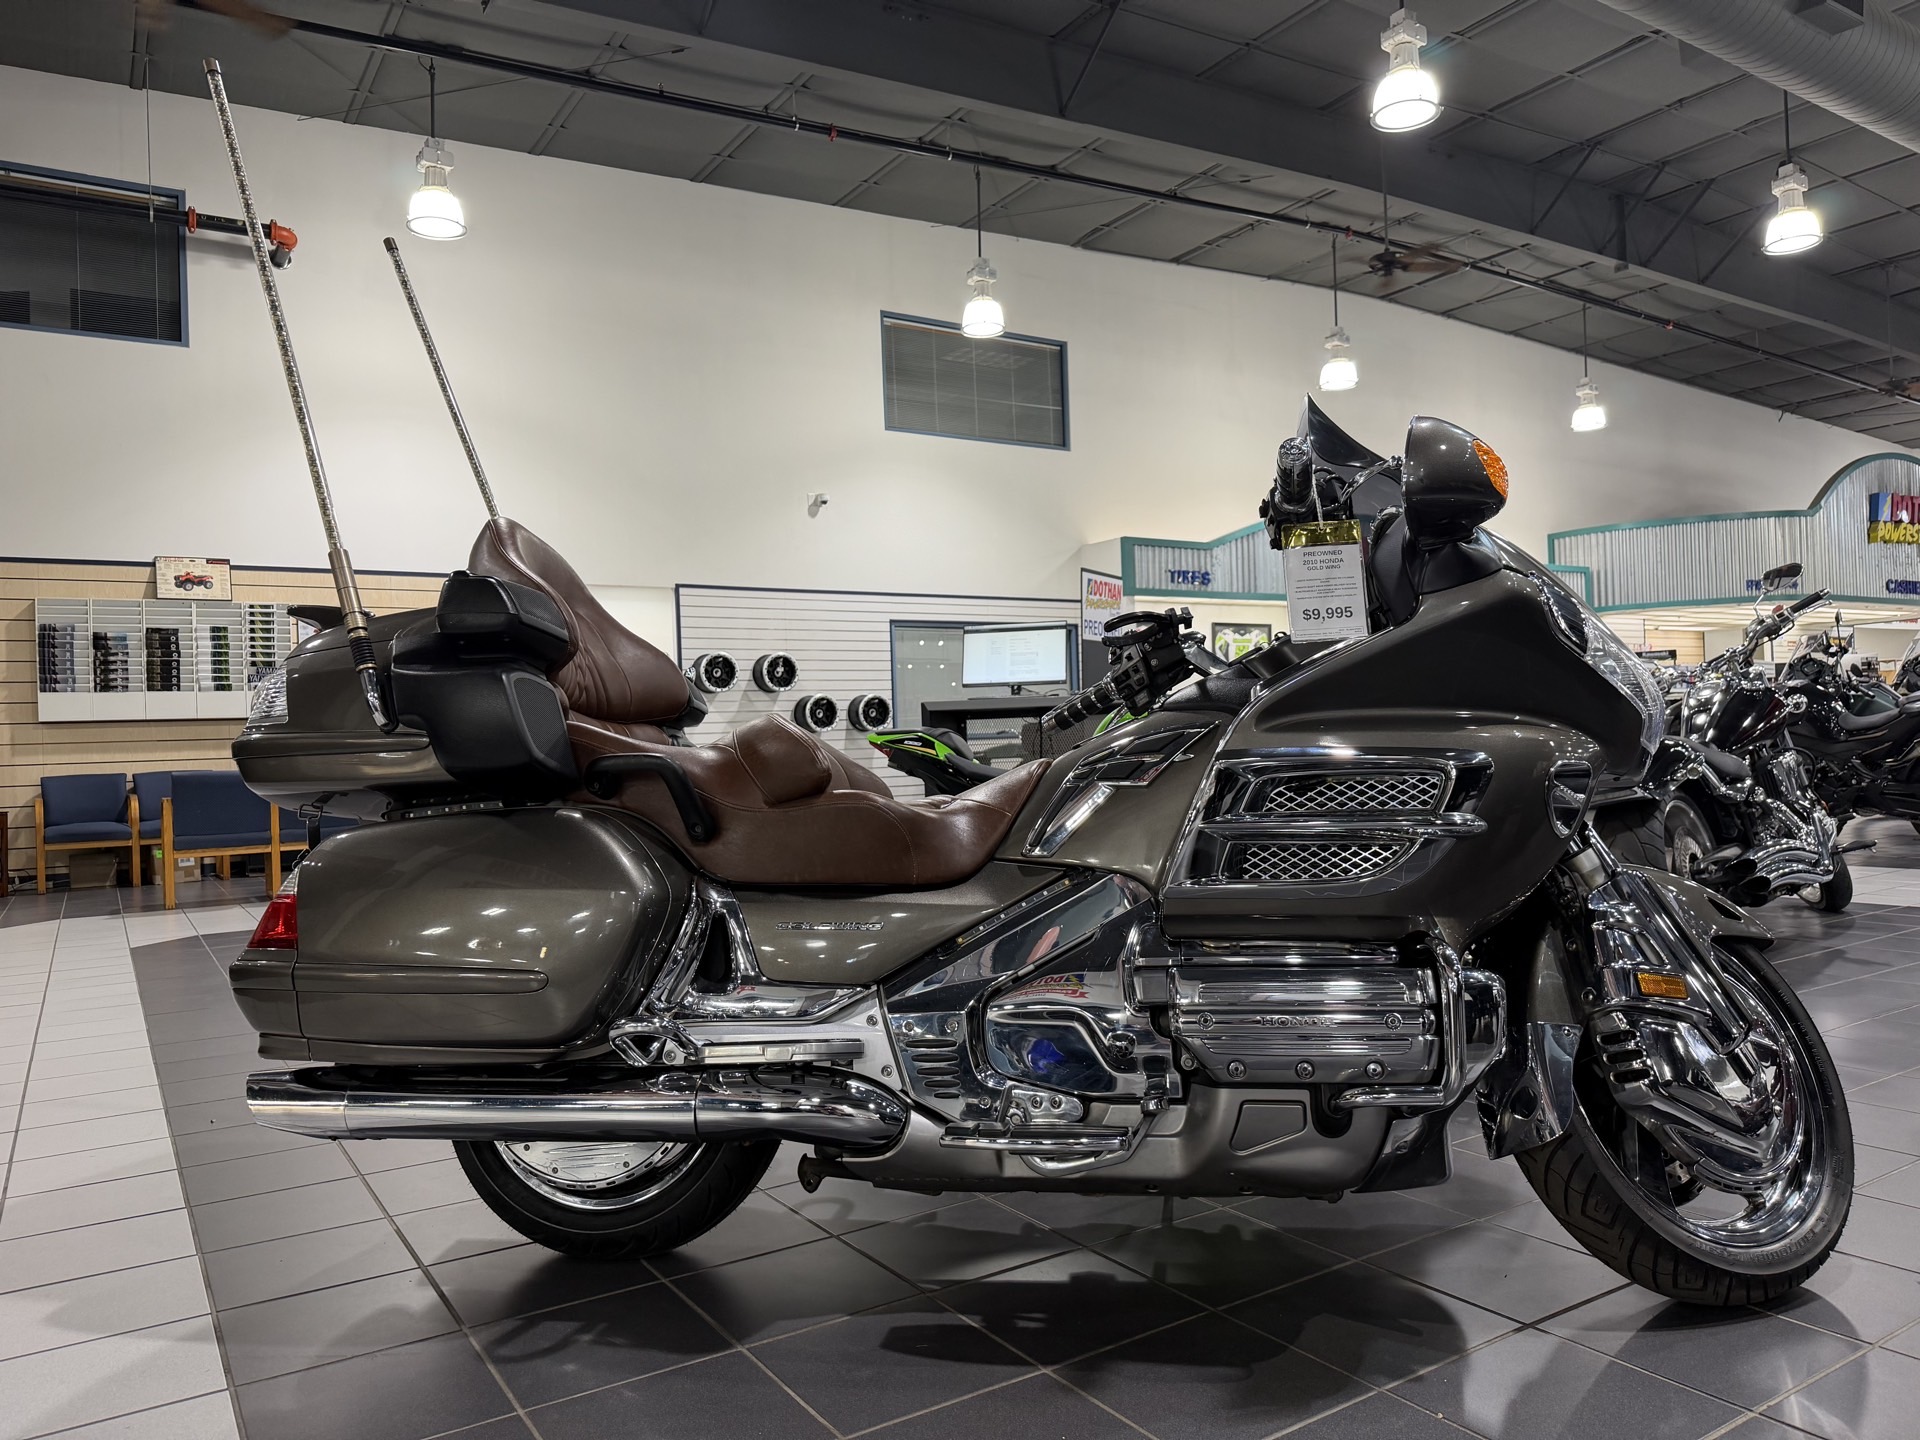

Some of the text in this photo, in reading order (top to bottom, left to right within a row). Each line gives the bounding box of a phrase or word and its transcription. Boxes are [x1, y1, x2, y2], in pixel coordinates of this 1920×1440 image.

[1877, 521, 1920, 543] POWERS
[1303, 549, 1343, 558] PREOWNED
[1319, 557, 1344, 565] HONDA
[1168, 569, 1211, 586] TIRES
[1093, 580, 1122, 601] DOTHAN
[1302, 606, 1353, 622] $9,995
[1257, 1016, 1338, 1028] HONDA
